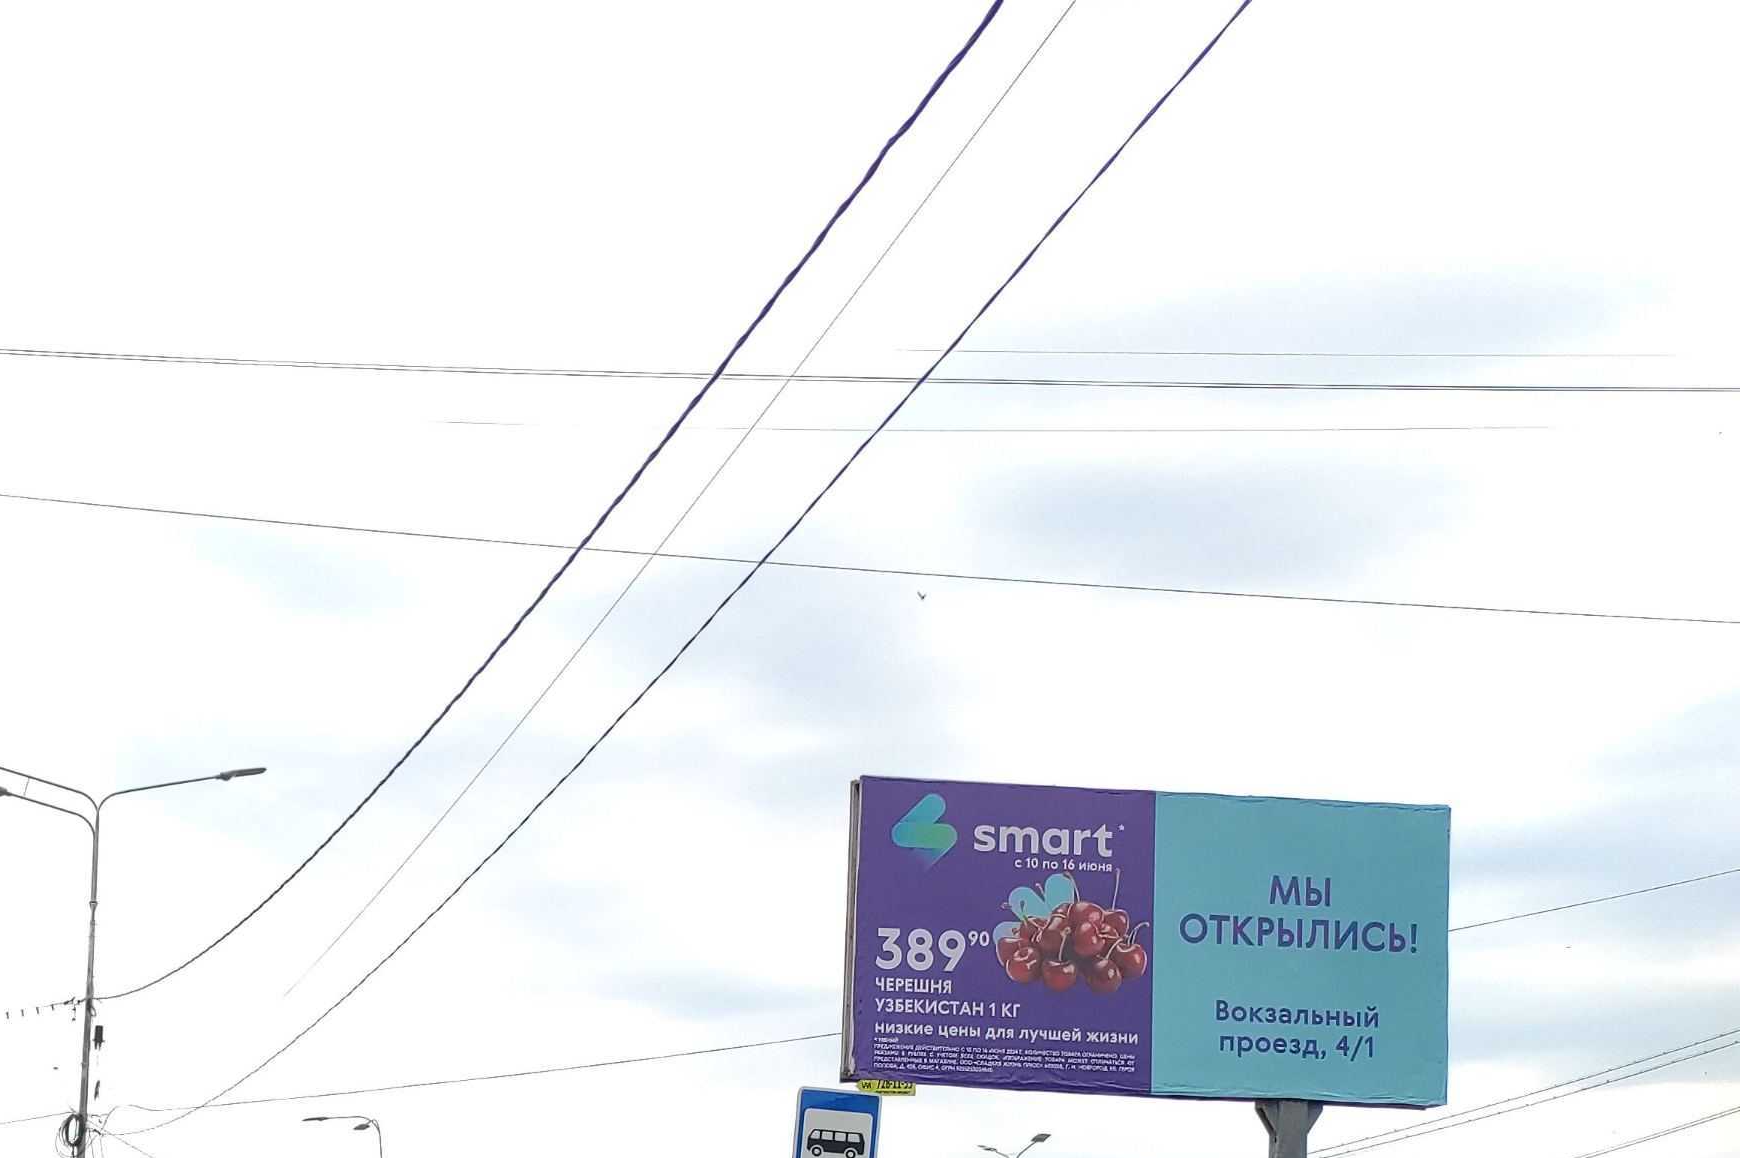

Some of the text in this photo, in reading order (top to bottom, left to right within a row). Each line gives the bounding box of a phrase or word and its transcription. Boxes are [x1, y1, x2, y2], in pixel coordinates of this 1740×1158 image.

[973, 823, 1113, 858] smart
[1026, 857, 1039, 869] 10
[1042, 860, 1059, 870] по
[1062, 858, 1075, 871] 16
[1078, 862, 1113, 872] июня
[1269, 875, 1331, 907] МЫ
[1179, 913, 1418, 954] ОТКРЫЛИСЬ!
[875, 927, 990, 972] 389 90
[875, 977, 952, 994] ЧЕРЕШНЯ
[875, 998, 1021, 1018] УЗБЕКИСТАН 1 КГ
[1215, 1000, 1380, 1029] Вокзальный
[938, 1025, 981, 1038] цены
[985, 1027, 1014, 1040] для
[1019, 1028, 1082, 1043] лучшей
[1086, 1031, 1139, 1045] жизни
[1219, 1035, 1374, 1062] проезд, 4/1
